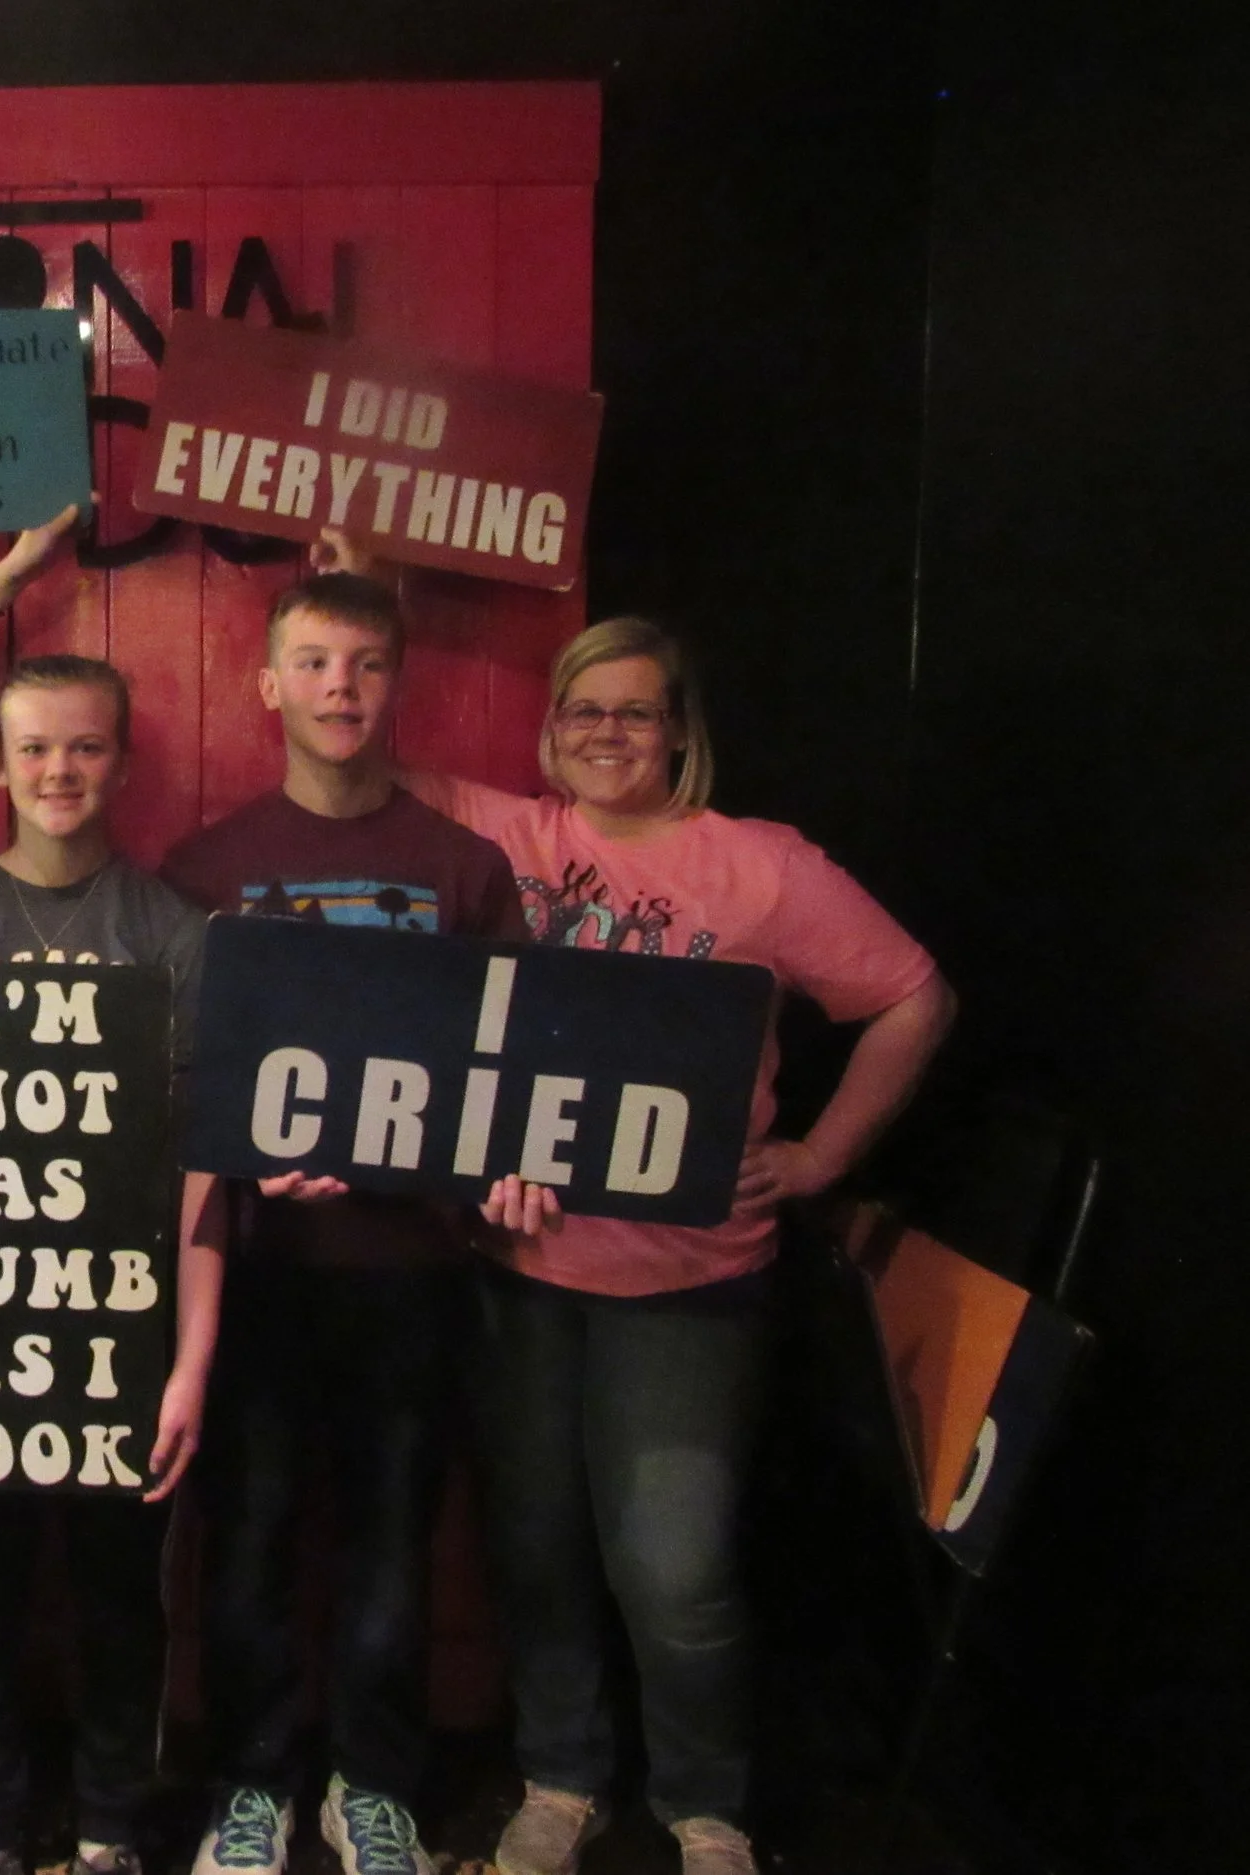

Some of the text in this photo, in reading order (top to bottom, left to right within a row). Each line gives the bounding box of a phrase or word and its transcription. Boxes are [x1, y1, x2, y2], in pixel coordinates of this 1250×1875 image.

[304, 371, 448, 449] I DID
[154, 420, 568, 565] EVERYTHING
[474, 955, 518, 1054] I
[250, 1046, 690, 1196] CRIED
[85, 1337, 119, 1399] I
